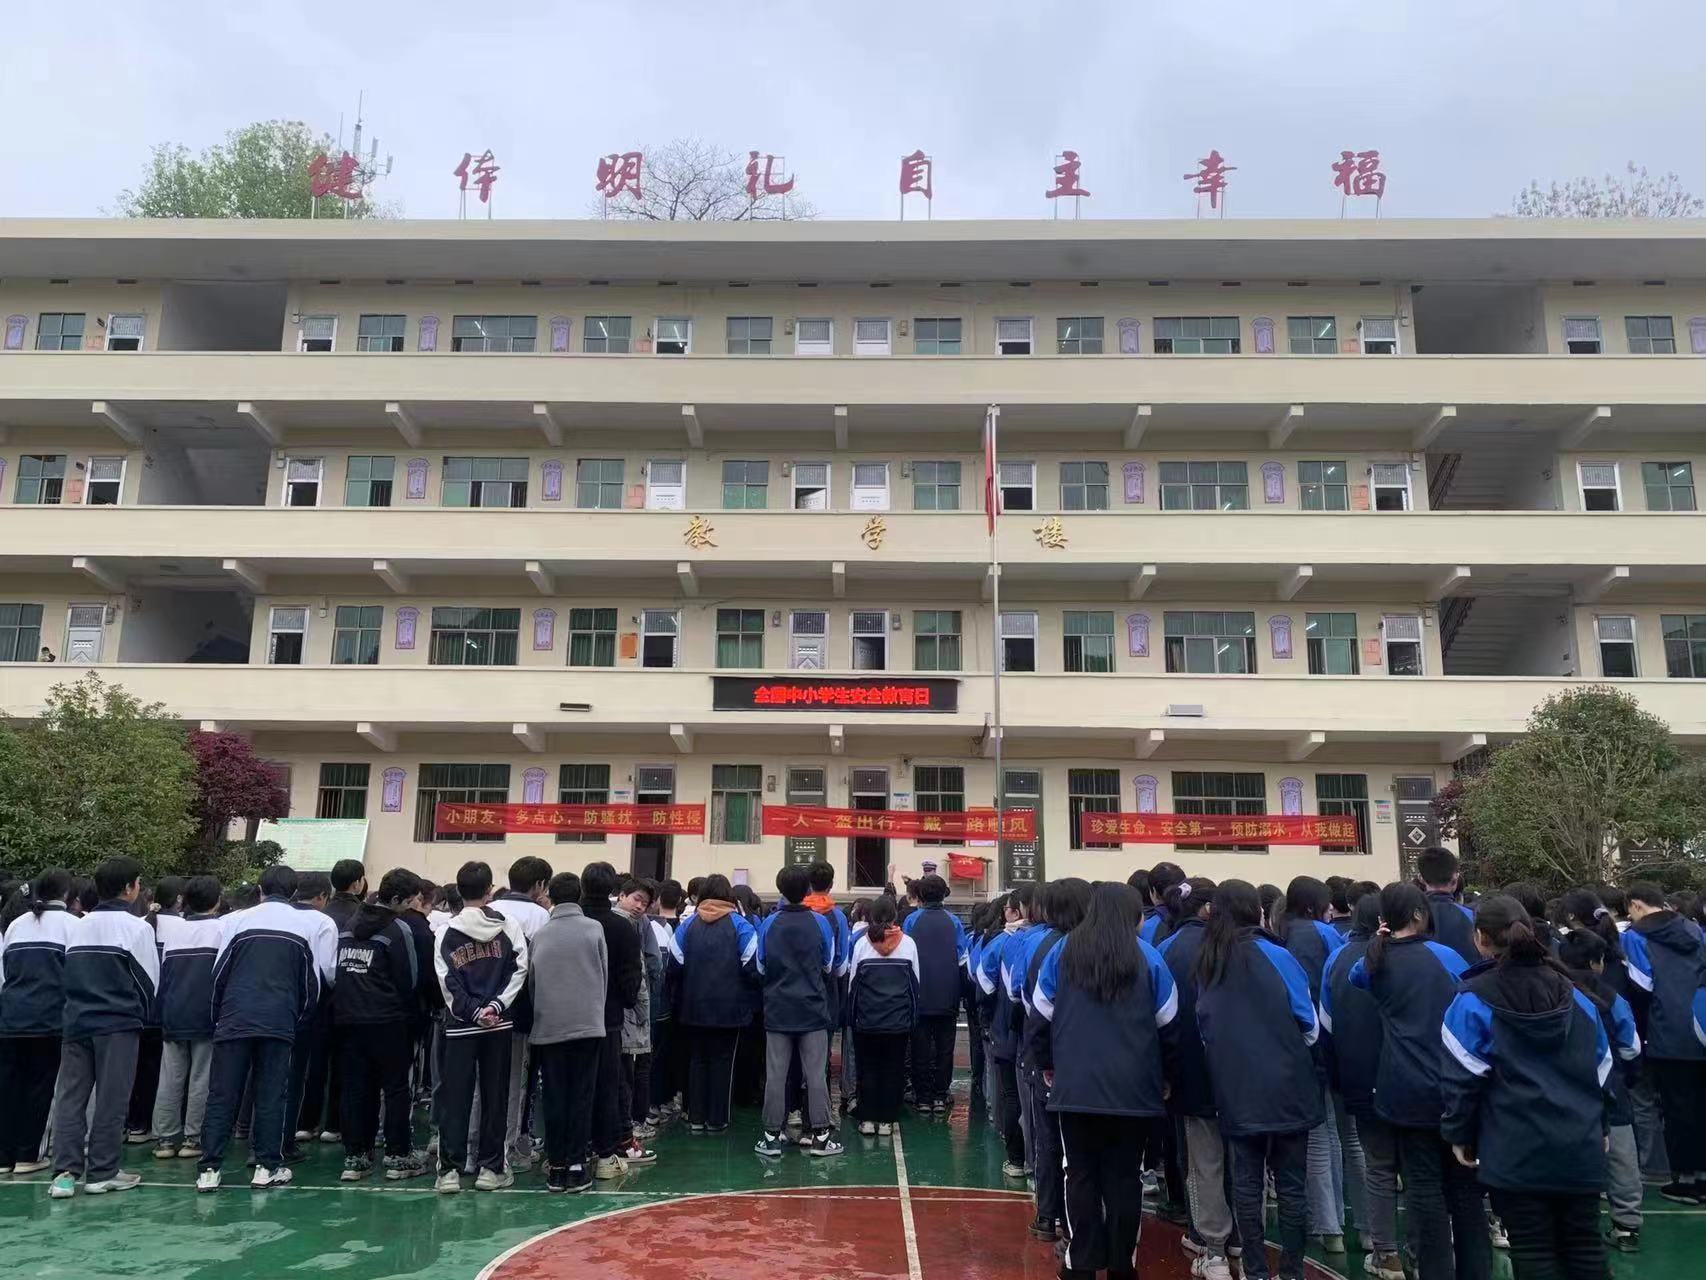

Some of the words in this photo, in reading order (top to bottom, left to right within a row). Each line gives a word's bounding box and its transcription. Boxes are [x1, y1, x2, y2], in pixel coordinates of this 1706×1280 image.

[683, 516, 1069, 551] 教学楼
[753, 685, 930, 705] 全国中小学生安全教育日
